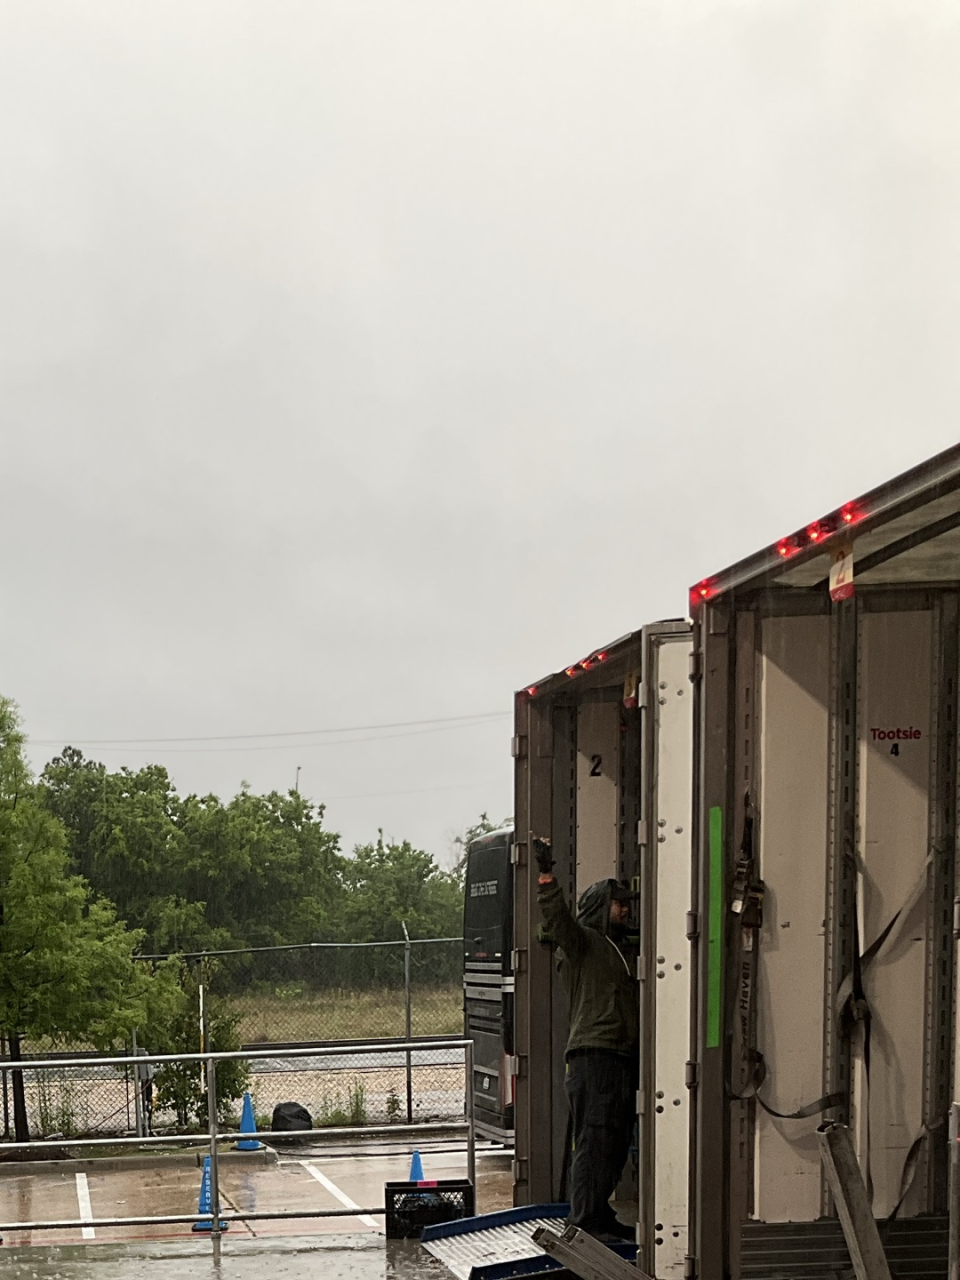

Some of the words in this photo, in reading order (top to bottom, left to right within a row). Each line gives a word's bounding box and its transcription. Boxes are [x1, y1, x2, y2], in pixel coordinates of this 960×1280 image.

[870, 726, 921, 741] Tootsie
[890, 743, 899, 756] 4
[590, 754, 602, 777] 2
[740, 961, 750, 1011] Haven
